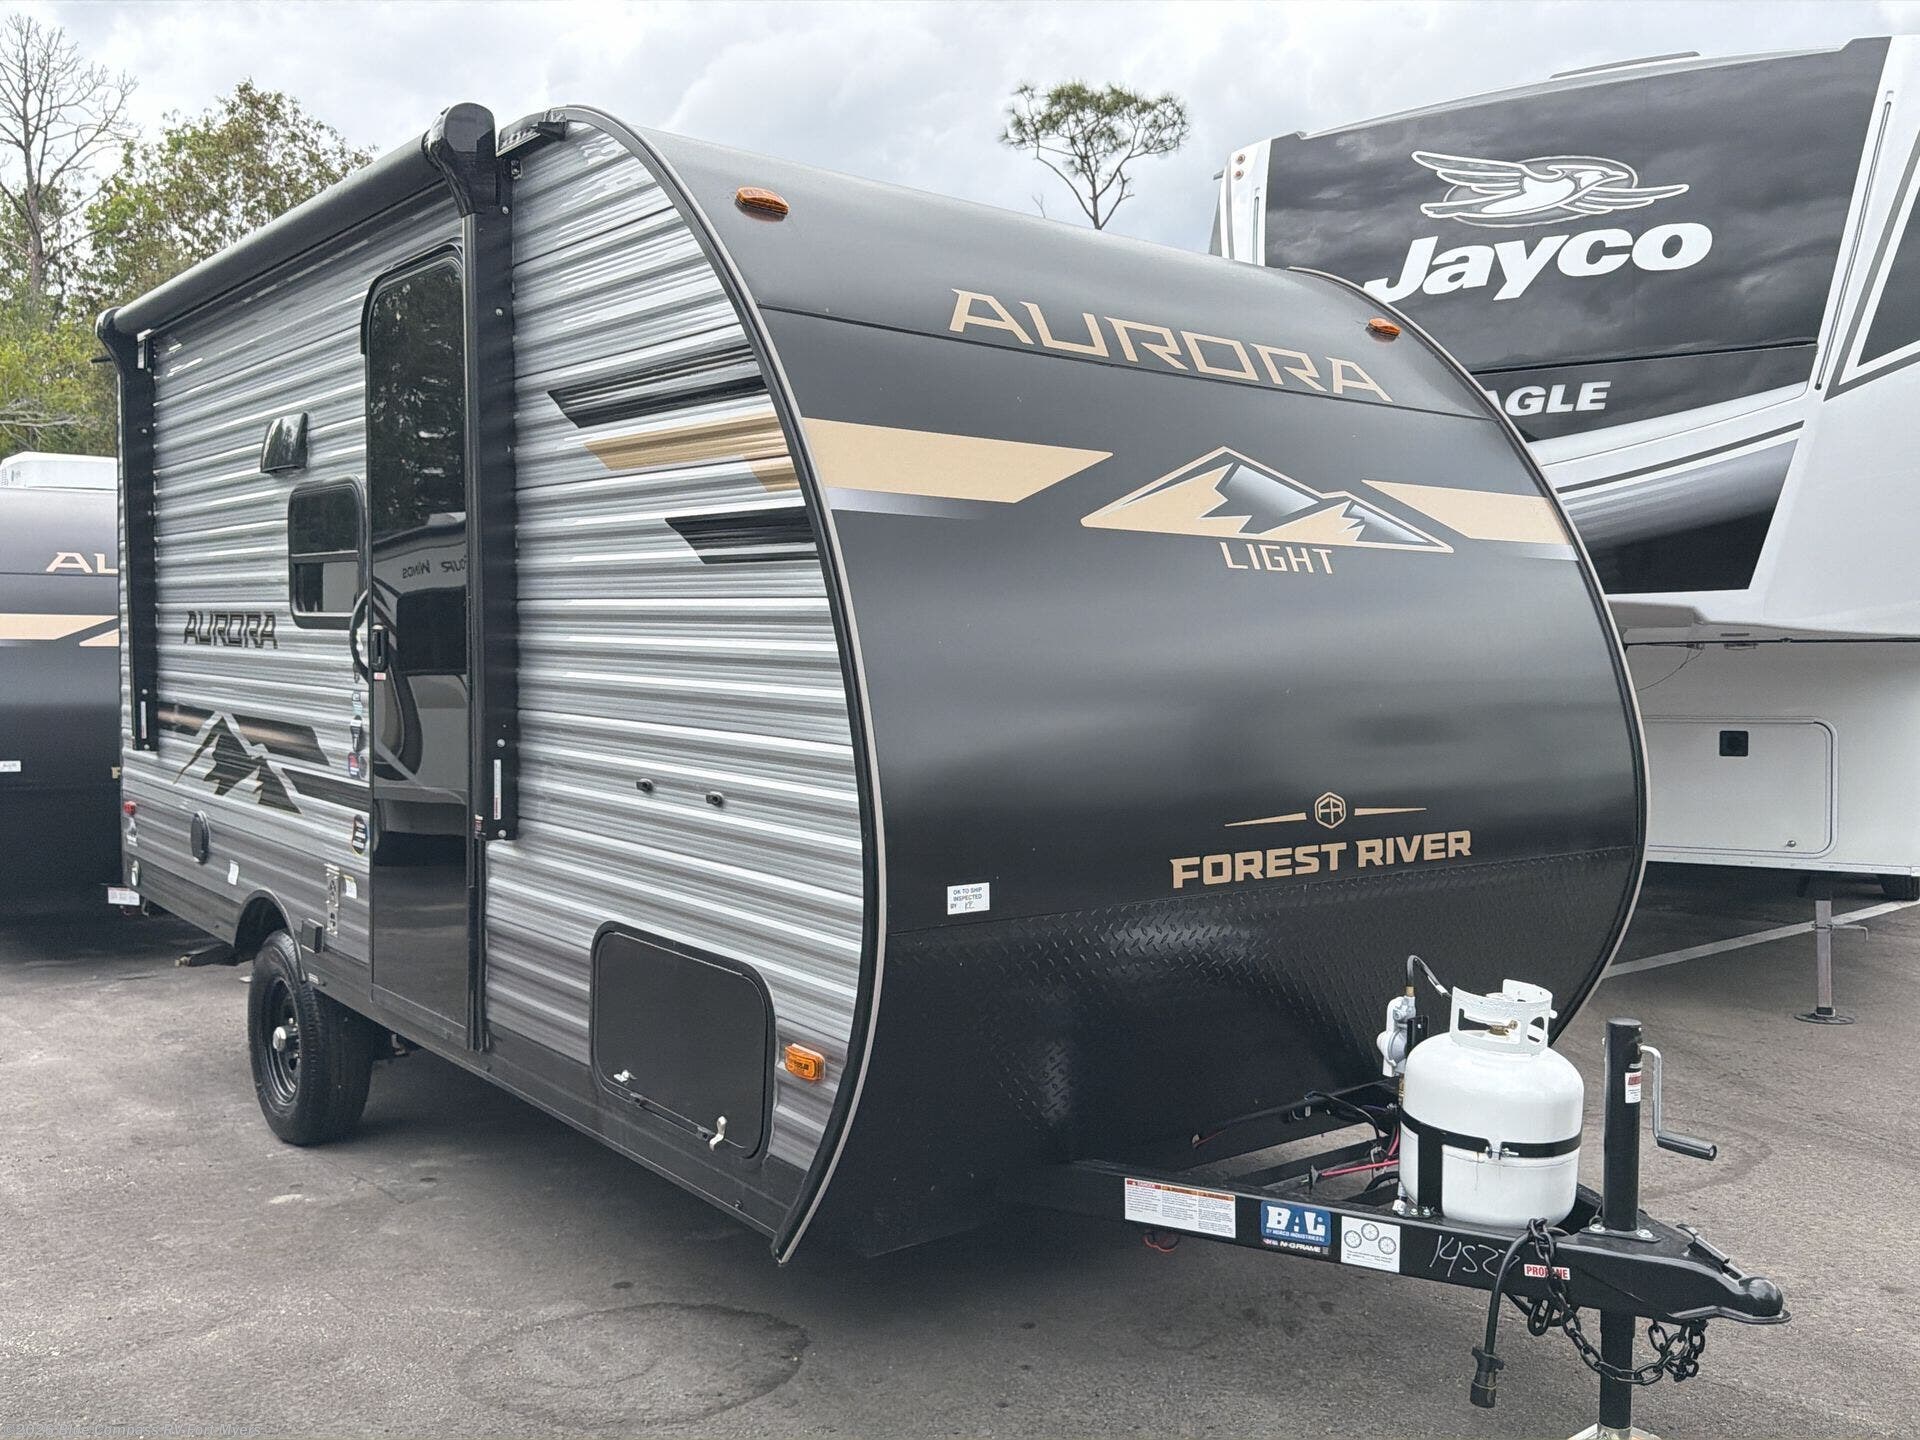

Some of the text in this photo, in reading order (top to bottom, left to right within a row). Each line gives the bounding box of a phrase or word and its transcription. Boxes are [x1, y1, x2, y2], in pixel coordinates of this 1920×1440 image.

[1363, 223, 1713, 303] Jayco
[949, 288, 1394, 402] AURORA
[1220, 542, 1333, 574] LIGHT
[183, 610, 278, 649] AURORA
[1170, 830, 1471, 889] FOREST RIVER
